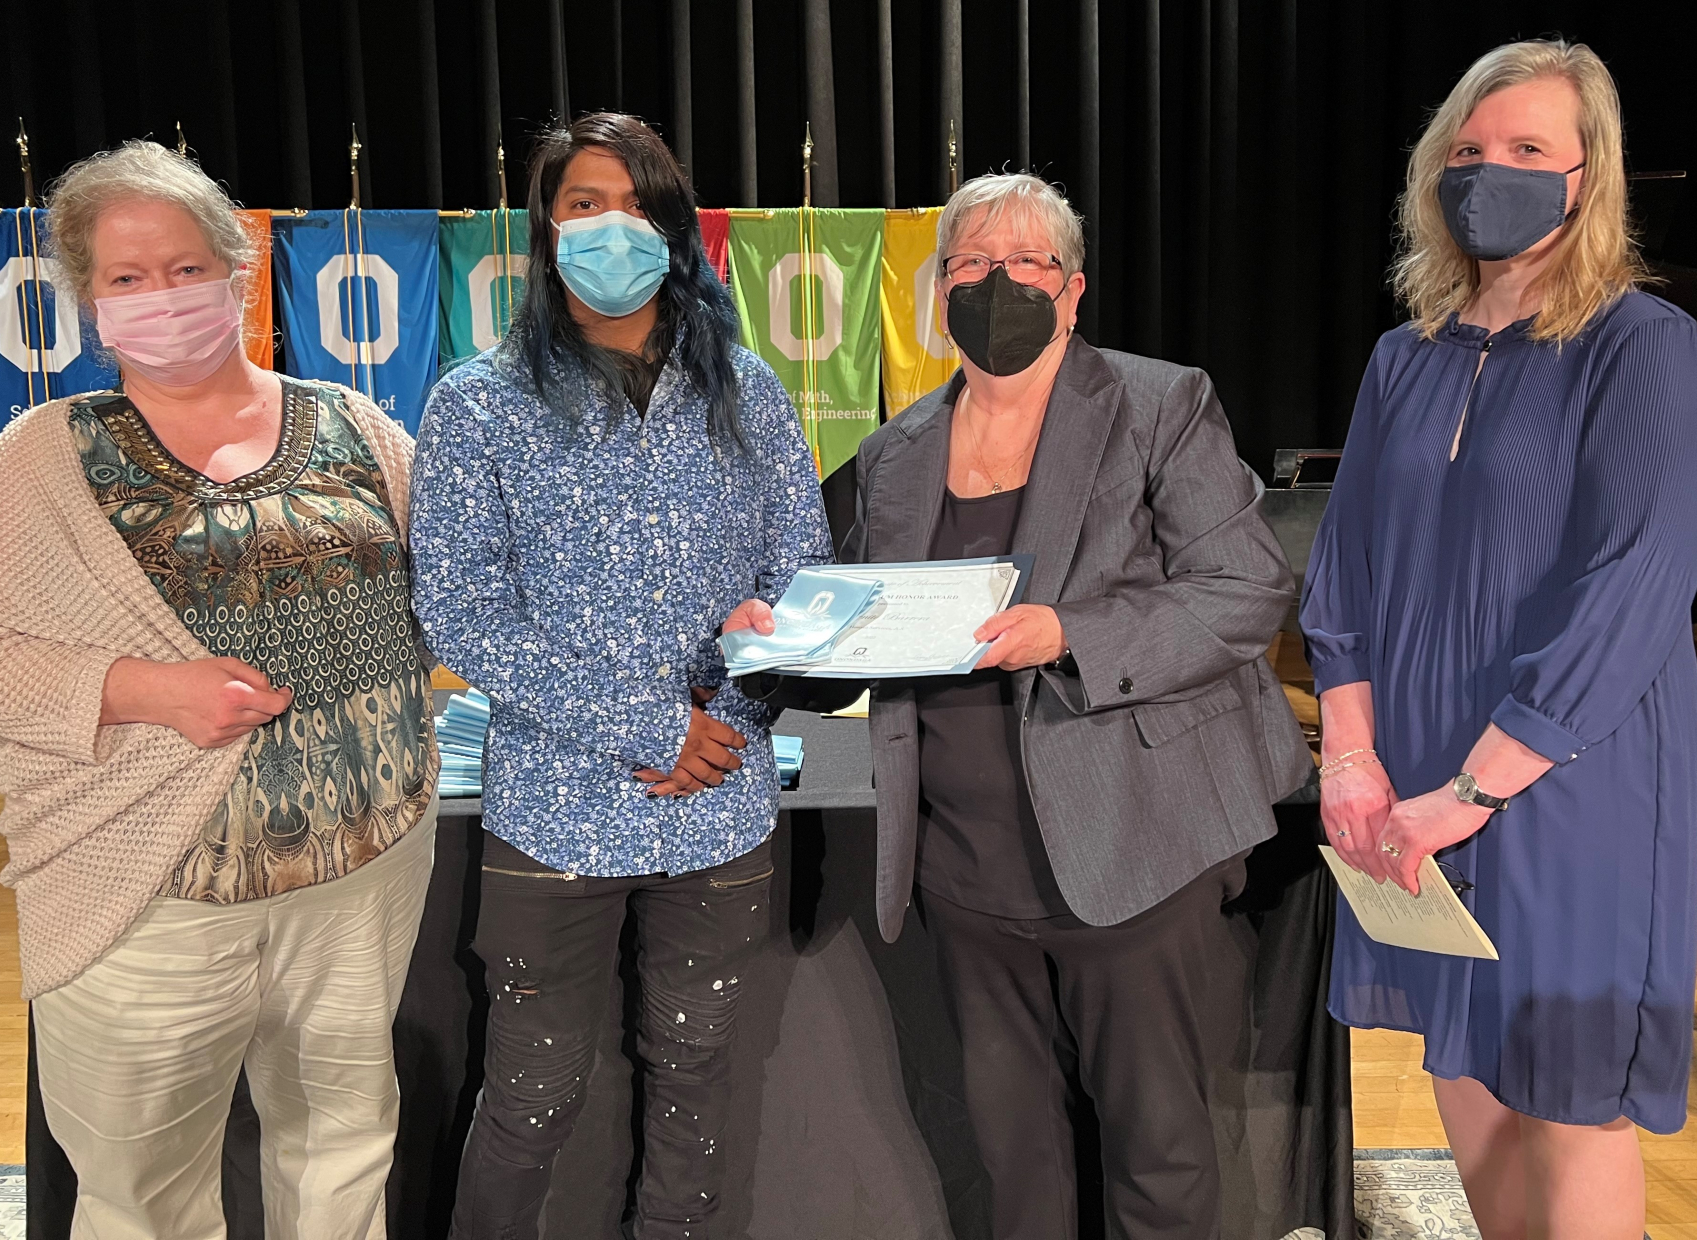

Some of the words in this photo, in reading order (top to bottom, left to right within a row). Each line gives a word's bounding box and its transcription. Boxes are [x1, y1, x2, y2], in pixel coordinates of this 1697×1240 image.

[316, 254, 399, 365] O
[769, 253, 843, 361] O
[379, 394, 396, 411] of
[801, 407, 877, 422] Engineering
